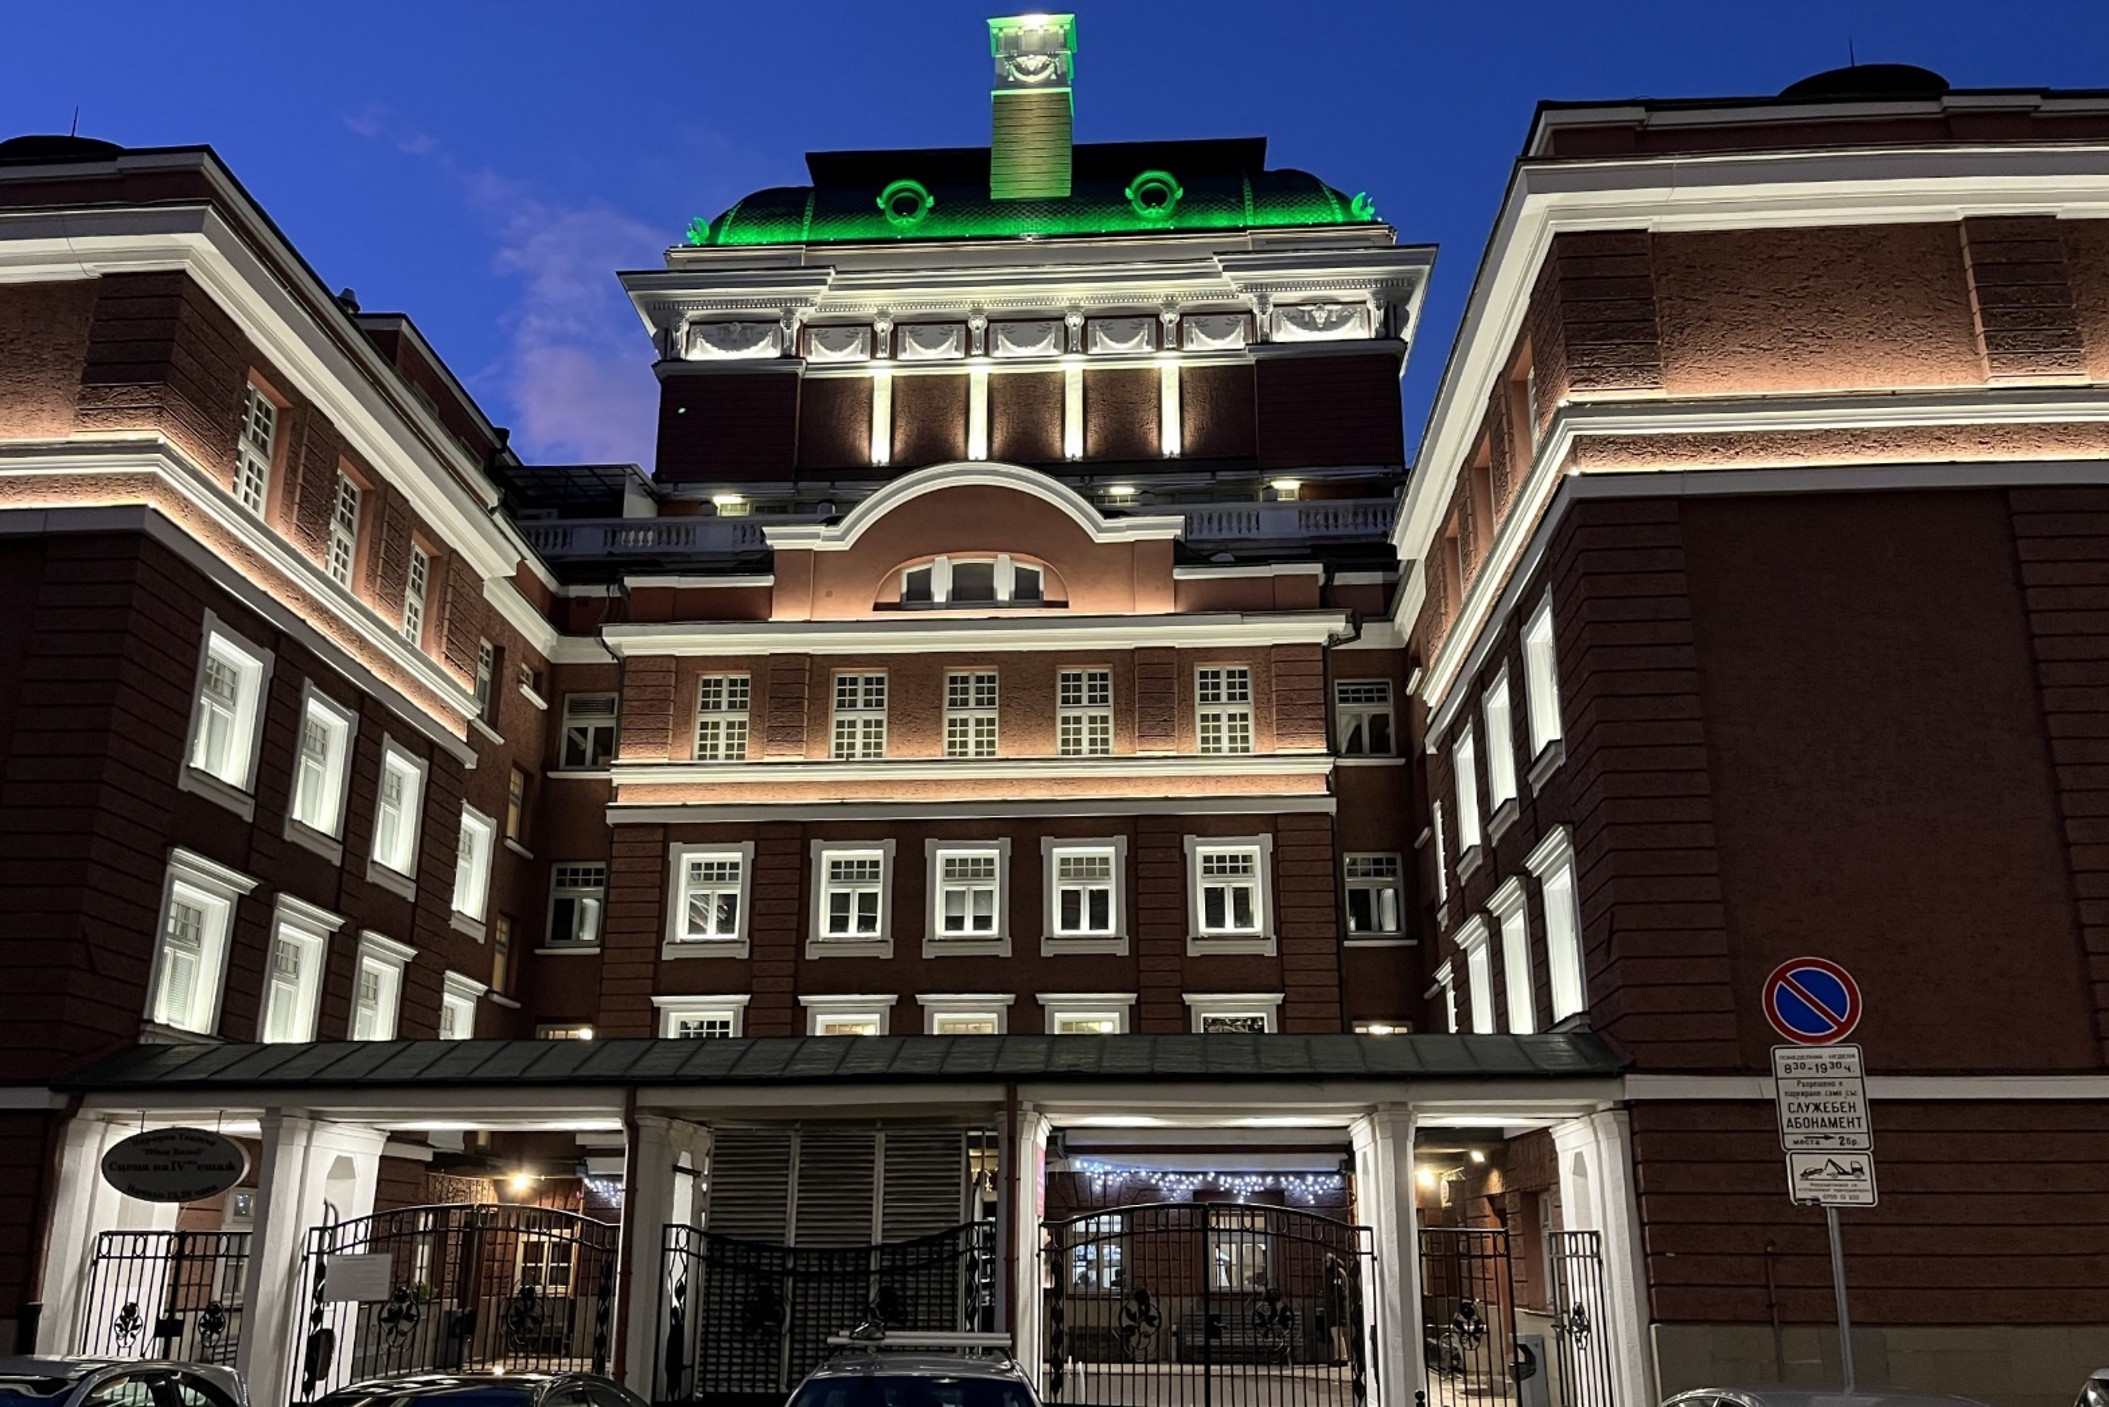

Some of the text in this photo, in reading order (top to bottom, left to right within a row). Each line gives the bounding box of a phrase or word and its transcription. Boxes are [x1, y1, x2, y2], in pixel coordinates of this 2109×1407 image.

[1787, 1101, 1857, 1114] СЛУЖЕБЕН
[1786, 1116, 1862, 1129] АБОНАМЕНТ
[108, 1161, 150, 1173] Сцена
